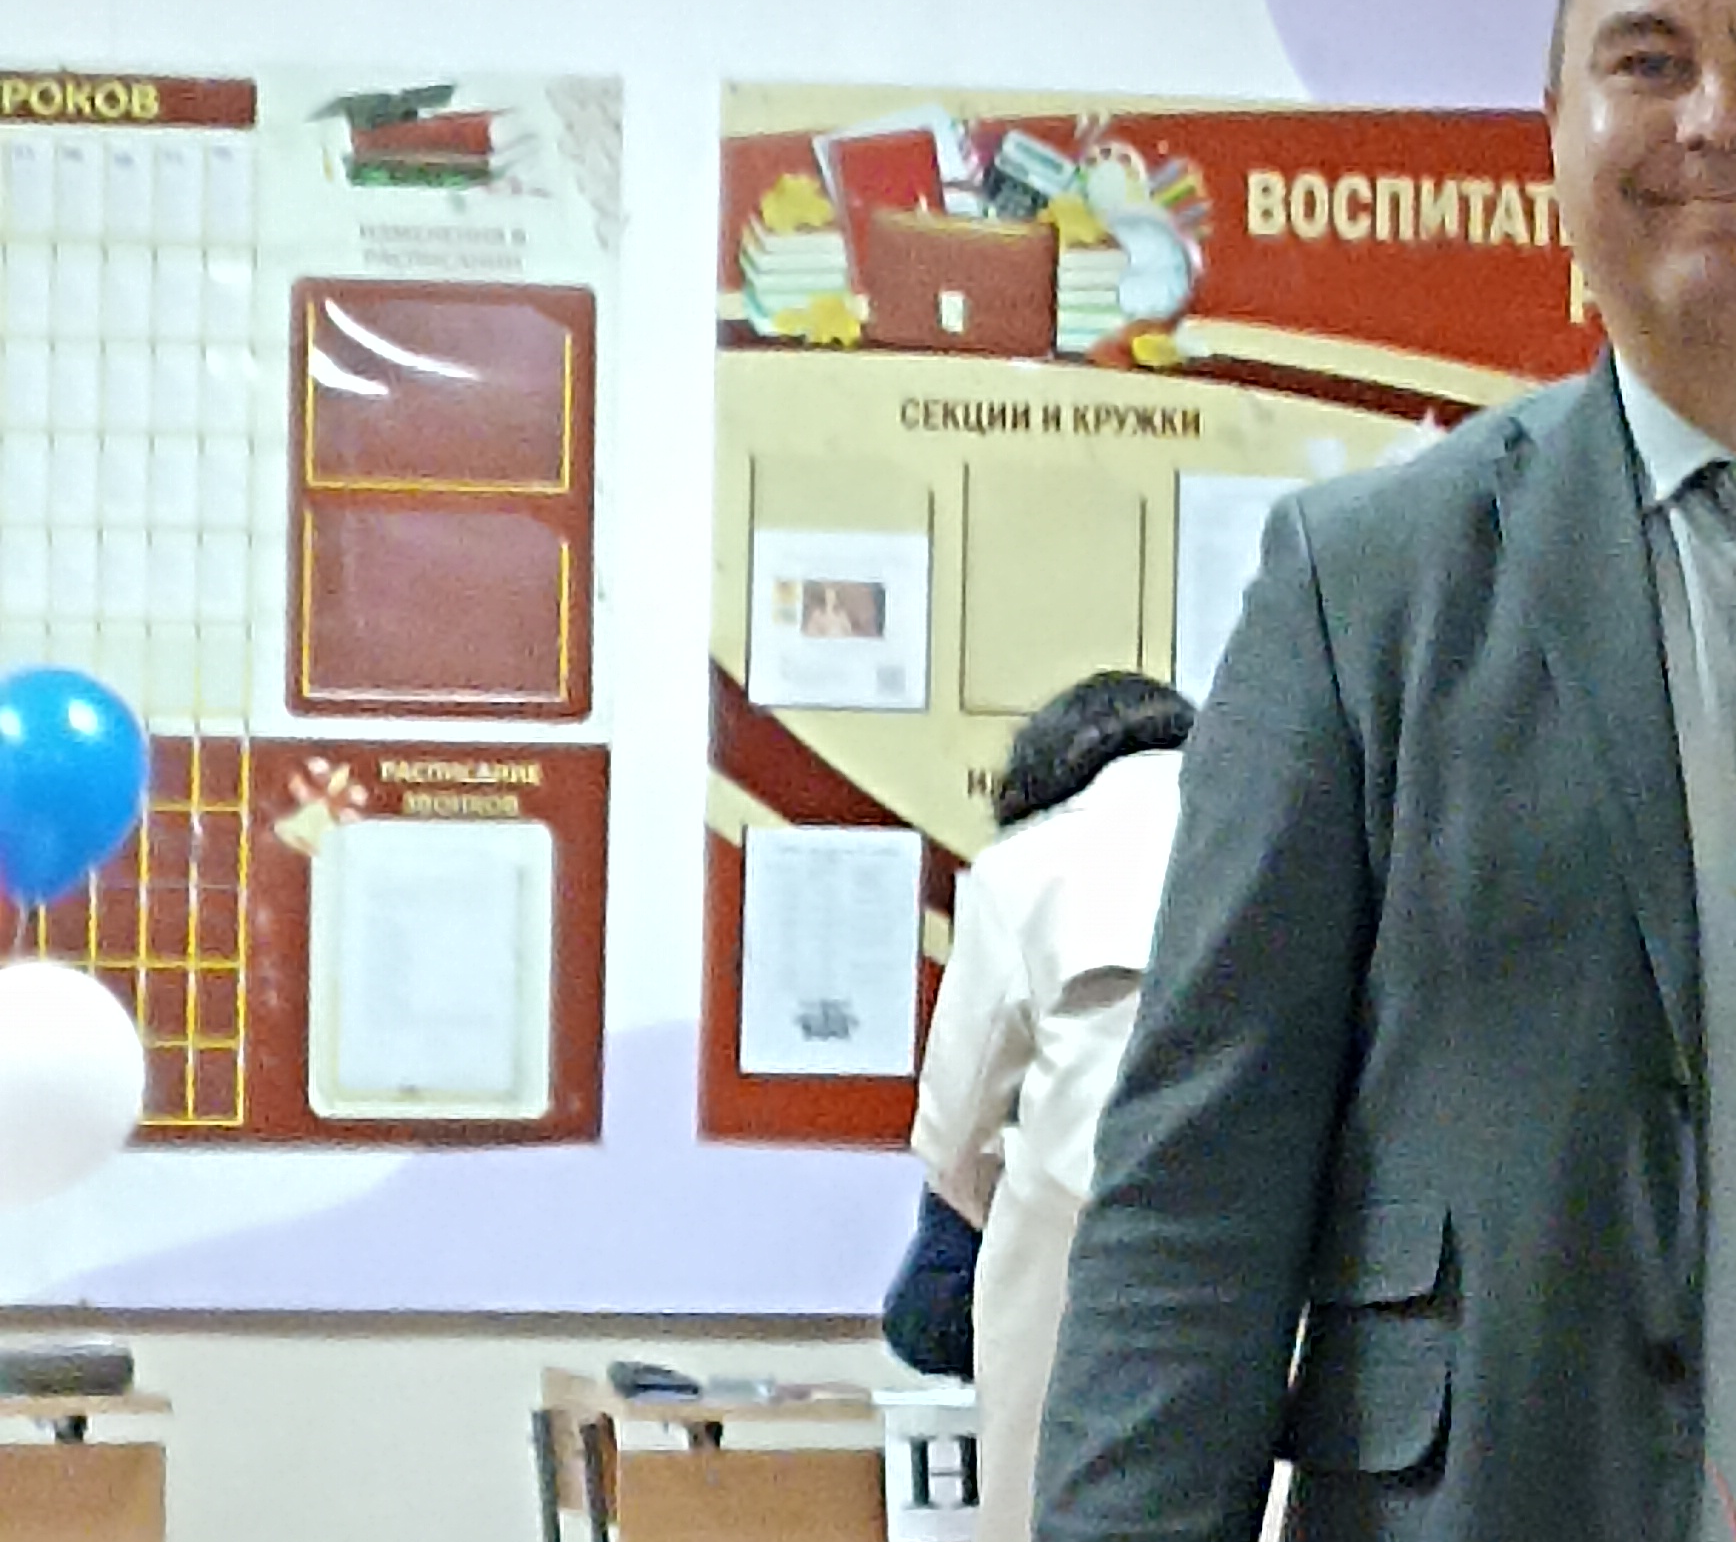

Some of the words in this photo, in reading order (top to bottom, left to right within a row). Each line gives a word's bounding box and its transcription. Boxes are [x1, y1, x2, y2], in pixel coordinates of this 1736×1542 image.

[1246, 169, 1577, 247] ВОСПИТАТ
[900, 397, 1031, 435] СЕКЦИИ
[1041, 403, 1062, 434] И
[1073, 403, 1202, 439] КРУЖКИ
